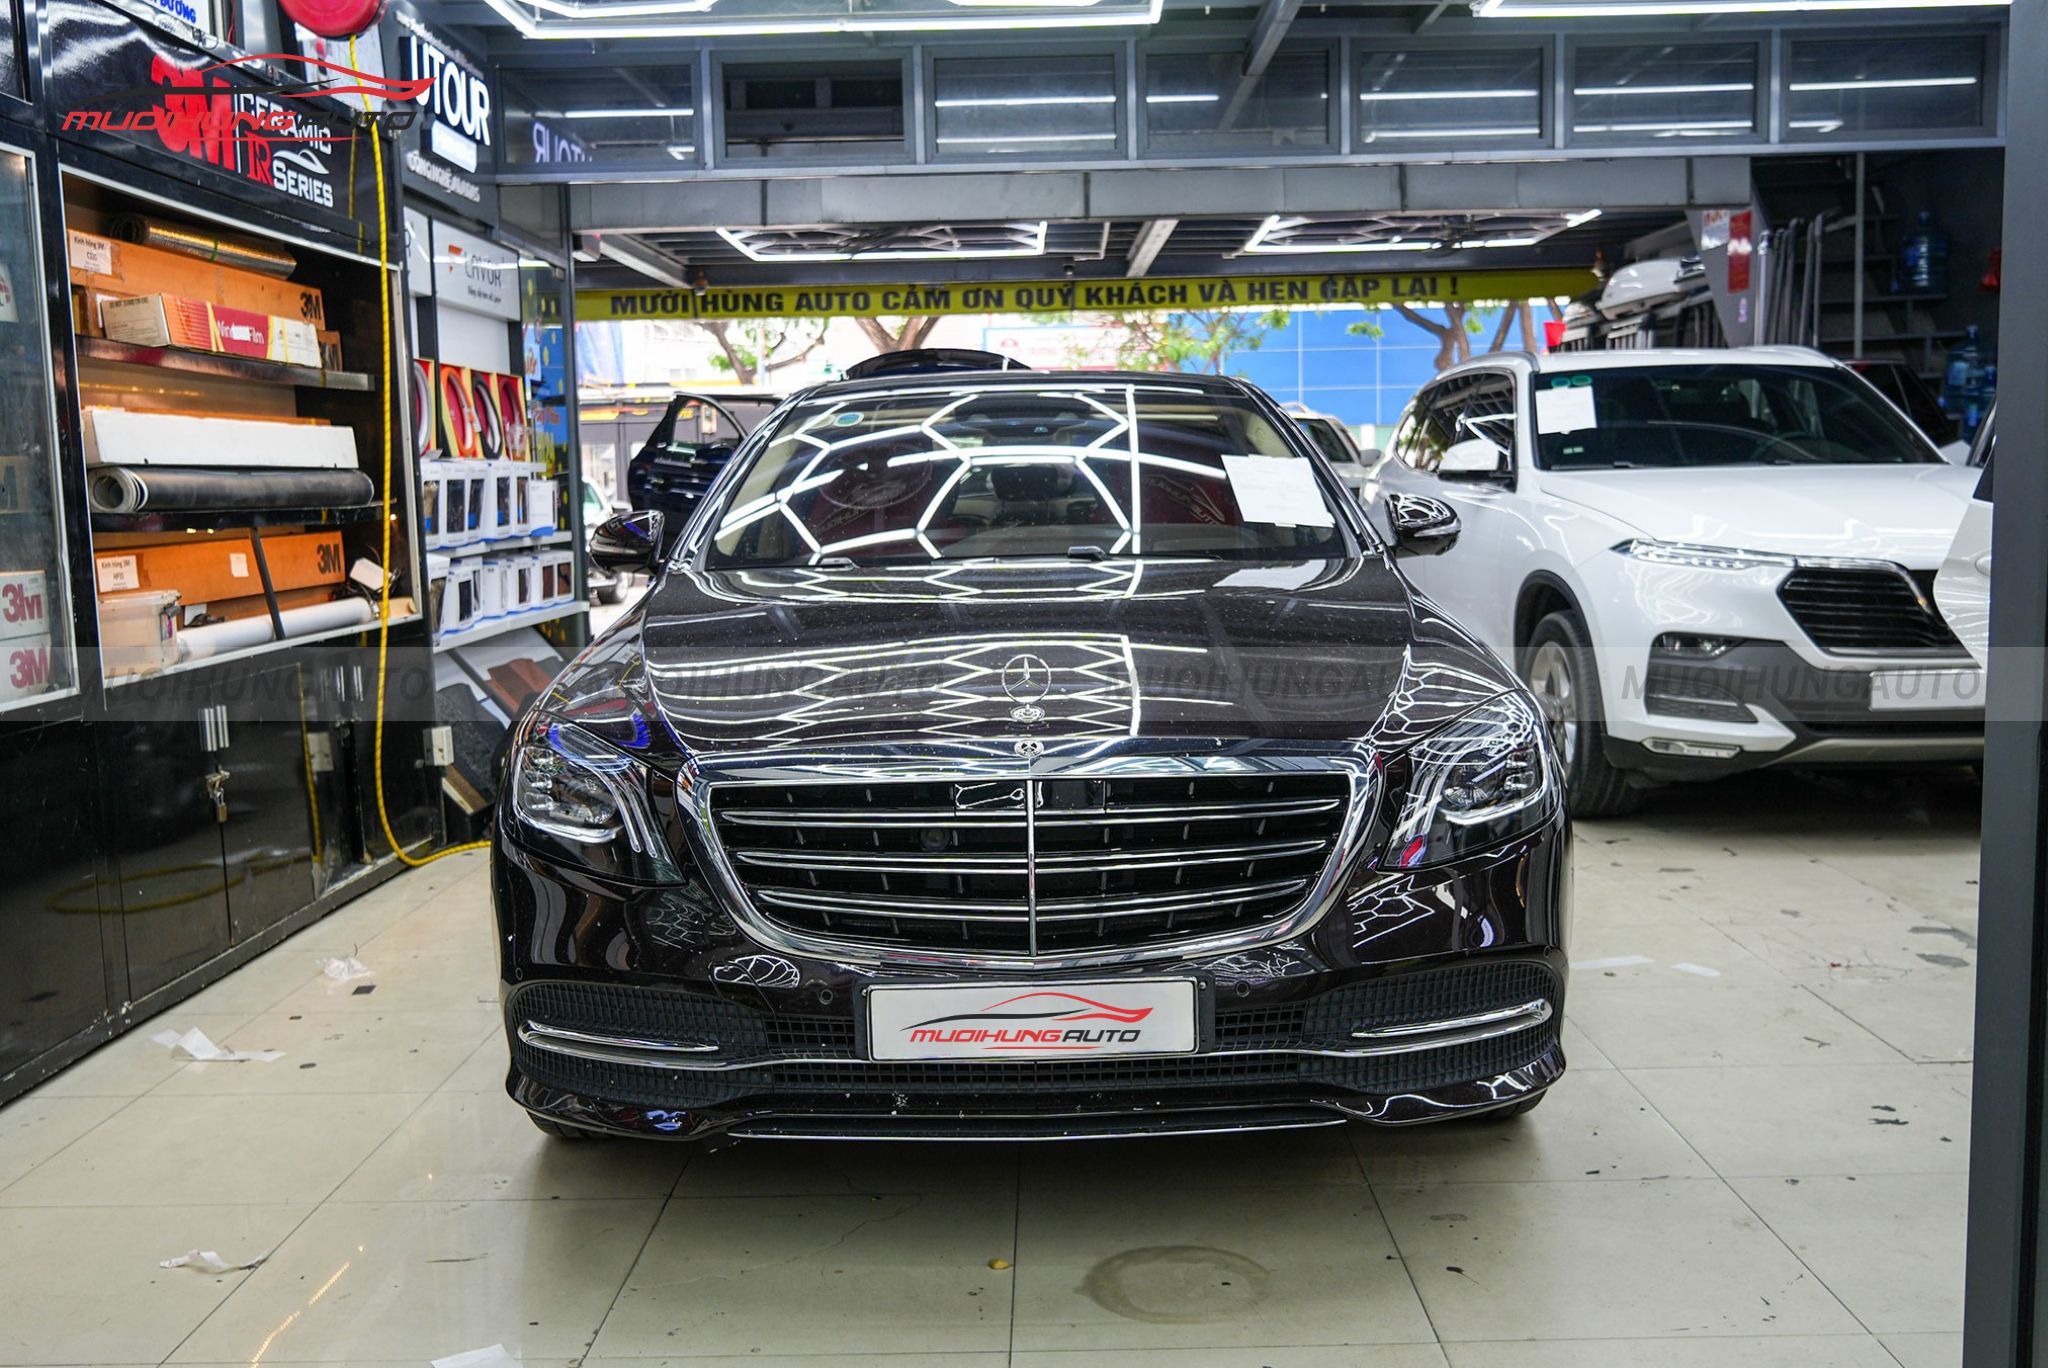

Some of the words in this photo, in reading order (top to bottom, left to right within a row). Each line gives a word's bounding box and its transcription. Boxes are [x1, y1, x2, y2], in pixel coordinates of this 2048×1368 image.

[152, 53, 236, 171] 3M
[272, 160, 334, 208] SERIES
[300, 291, 322, 320] 3M
[610, 290, 689, 315] MƯỜI
[701, 289, 784, 312] HÙNG
[795, 291, 871, 312] AUTO
[882, 284, 951, 310] CẢM
[962, 287, 1004, 309] ƠN
[1015, 284, 1074, 309] QUÝ
[1085, 282, 1188, 306] KHÁCH
[1197, 279, 1237, 303] VÀ
[1247, 280, 1308, 304] HẸN
[1320, 276, 1380, 302] GẶP
[1391, 276, 1437, 300] LẠI
[316, 543, 342, 575] 3M
[2, 583, 43, 623] 3M
[9, 645, 49, 689] 3M
